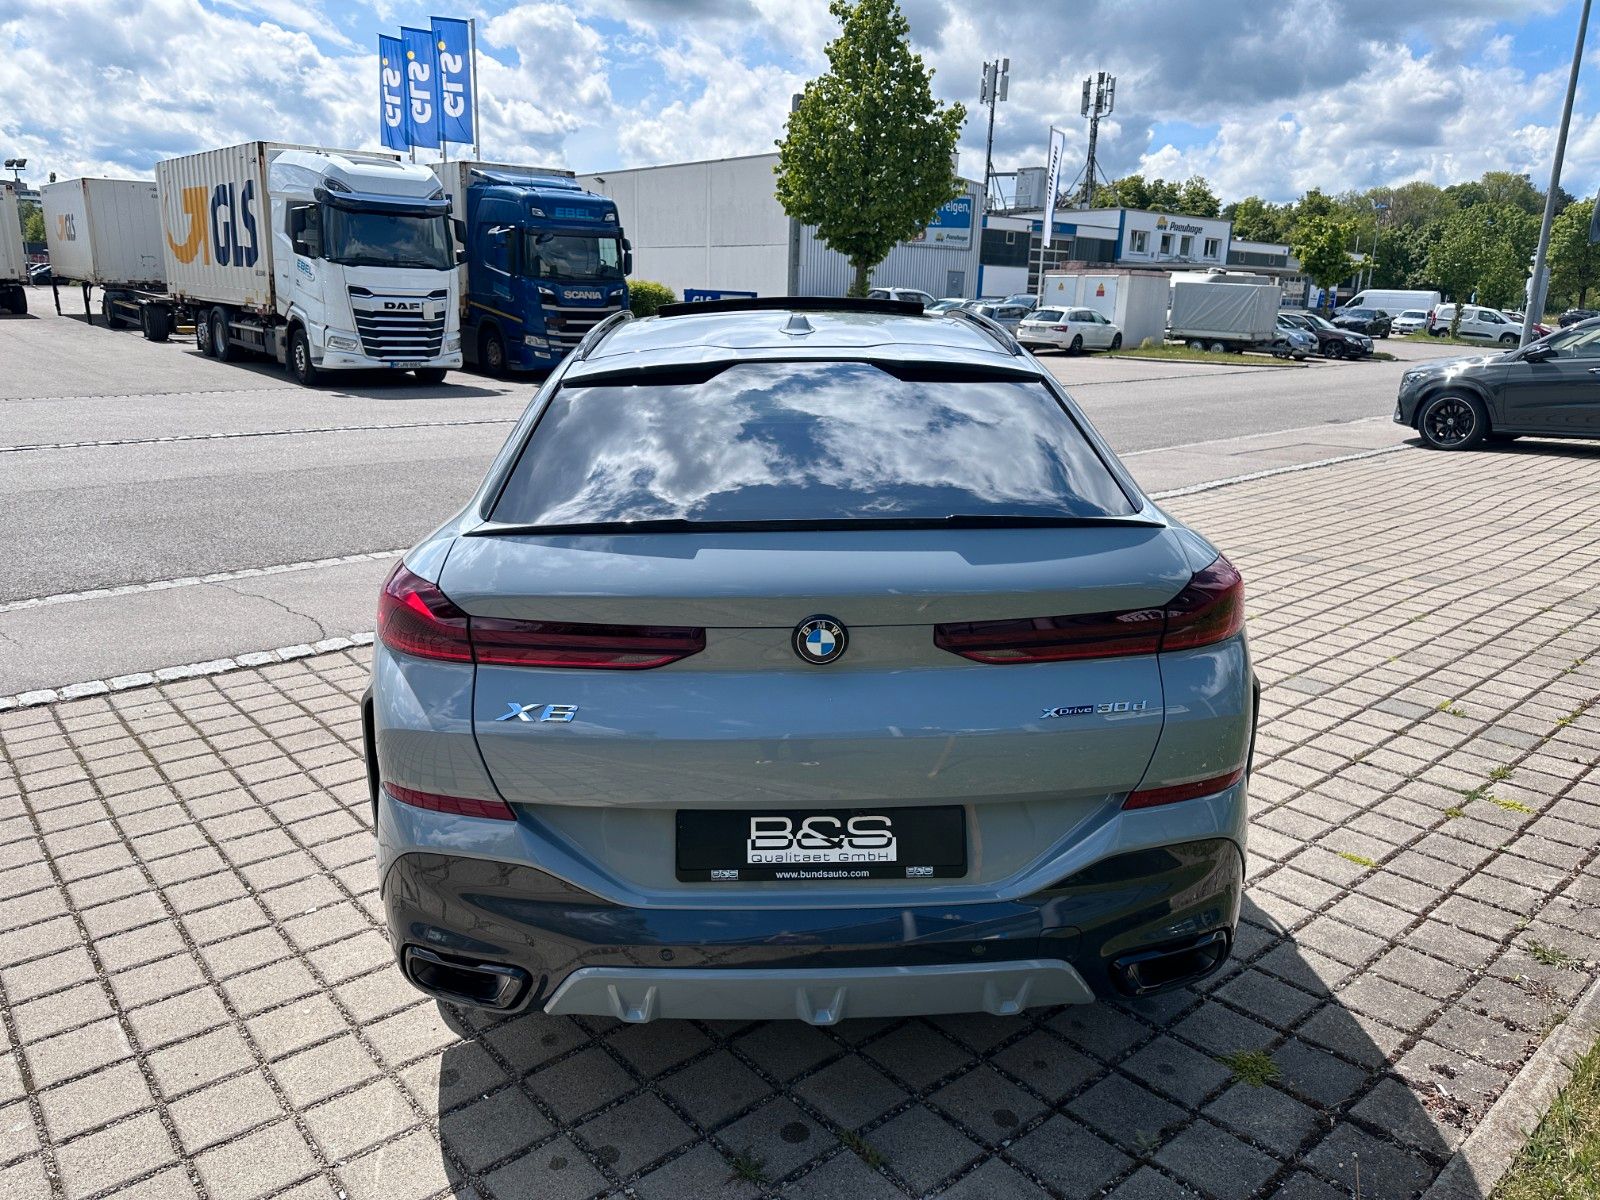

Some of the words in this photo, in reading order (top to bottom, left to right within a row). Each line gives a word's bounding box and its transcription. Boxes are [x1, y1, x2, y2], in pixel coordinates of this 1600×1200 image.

[554, 207, 595, 219] EBEL
[64, 213, 76, 241] GLS
[210, 179, 259, 267] GLS
[296, 258, 313, 276] EBEL
[563, 290, 602, 300] SCANIA
[383, 301, 420, 310] DAF
[803, 620, 840, 637] BMW
[496, 702, 580, 722] X6
[1096, 700, 1148, 714] 30d
[750, 815, 893, 851] B&S
[751, 851, 831, 863] Qualitaet
[775, 869, 870, 879] www.bundsauto.com
